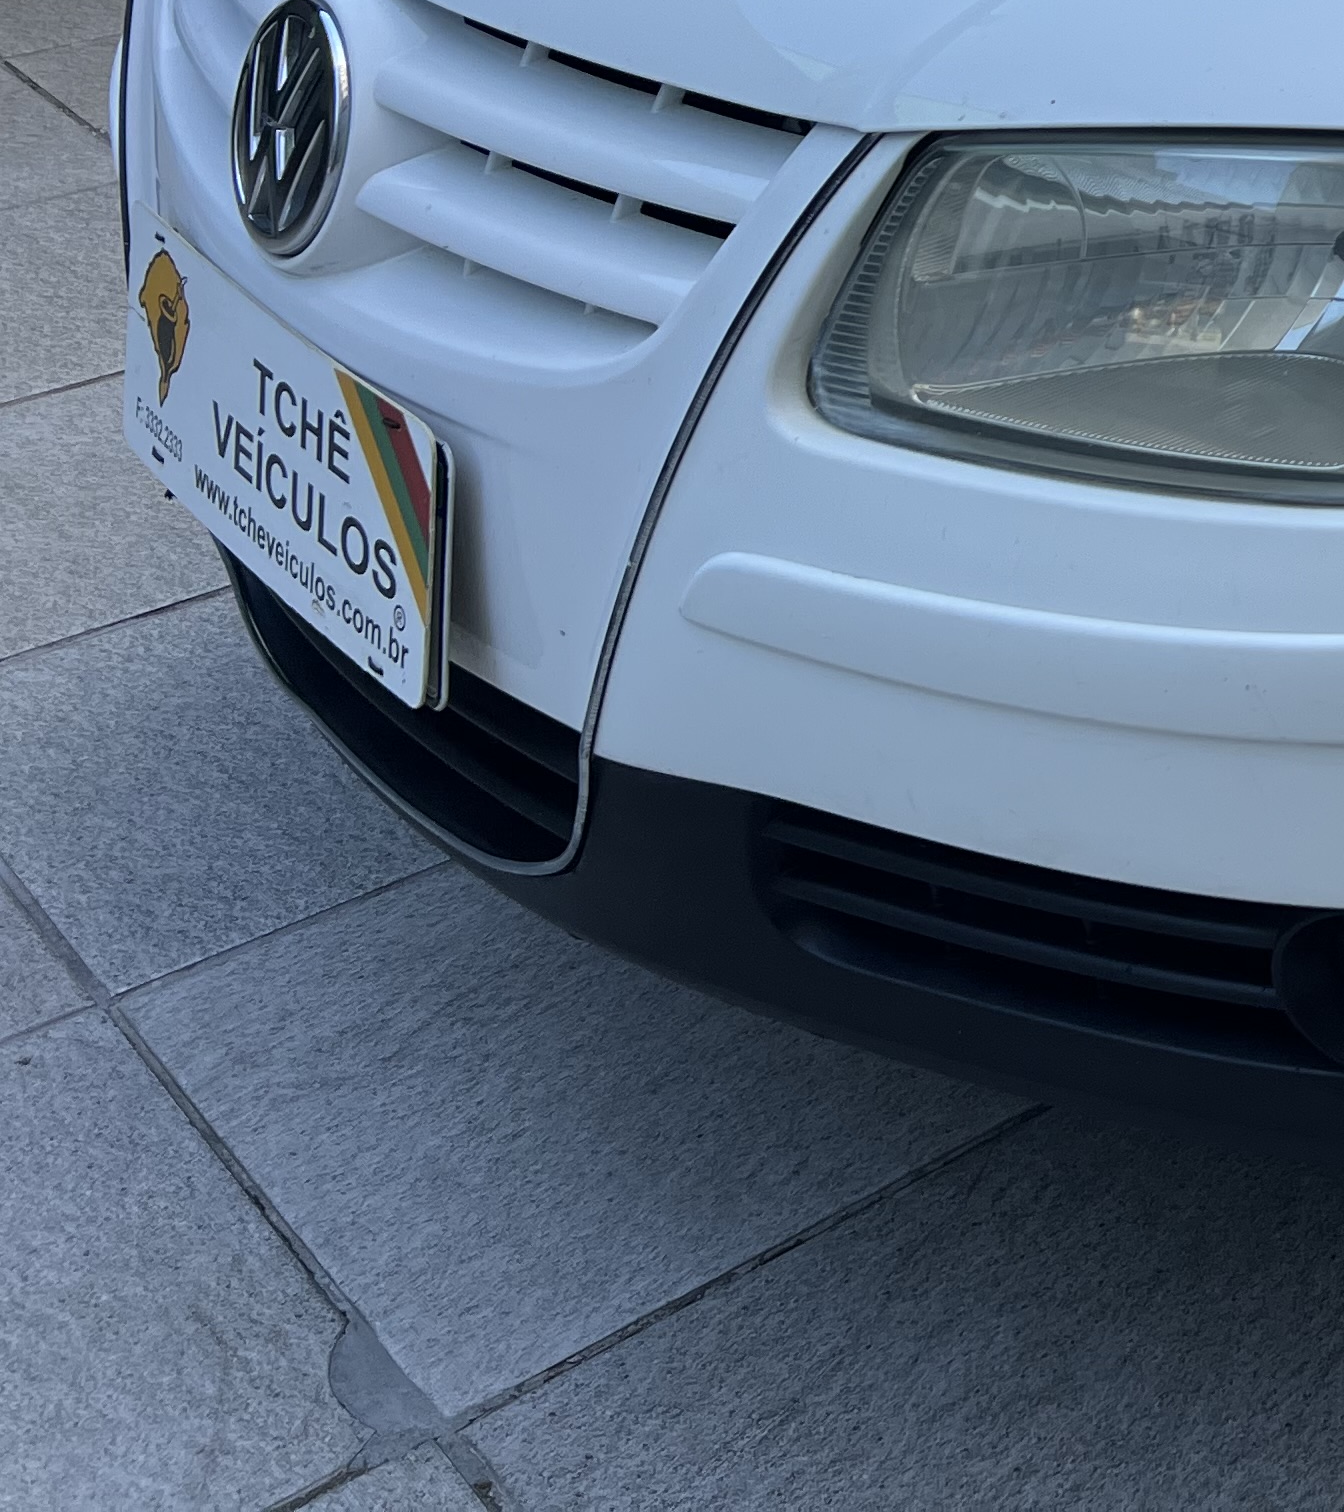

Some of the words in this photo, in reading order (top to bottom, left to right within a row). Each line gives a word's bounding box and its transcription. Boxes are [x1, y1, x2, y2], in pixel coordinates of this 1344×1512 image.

[212, 399, 398, 600] VEÍCULOS
[253, 357, 351, 485] TCHÊ
[194, 463, 409, 670] www.tcheveiculos.com.br
